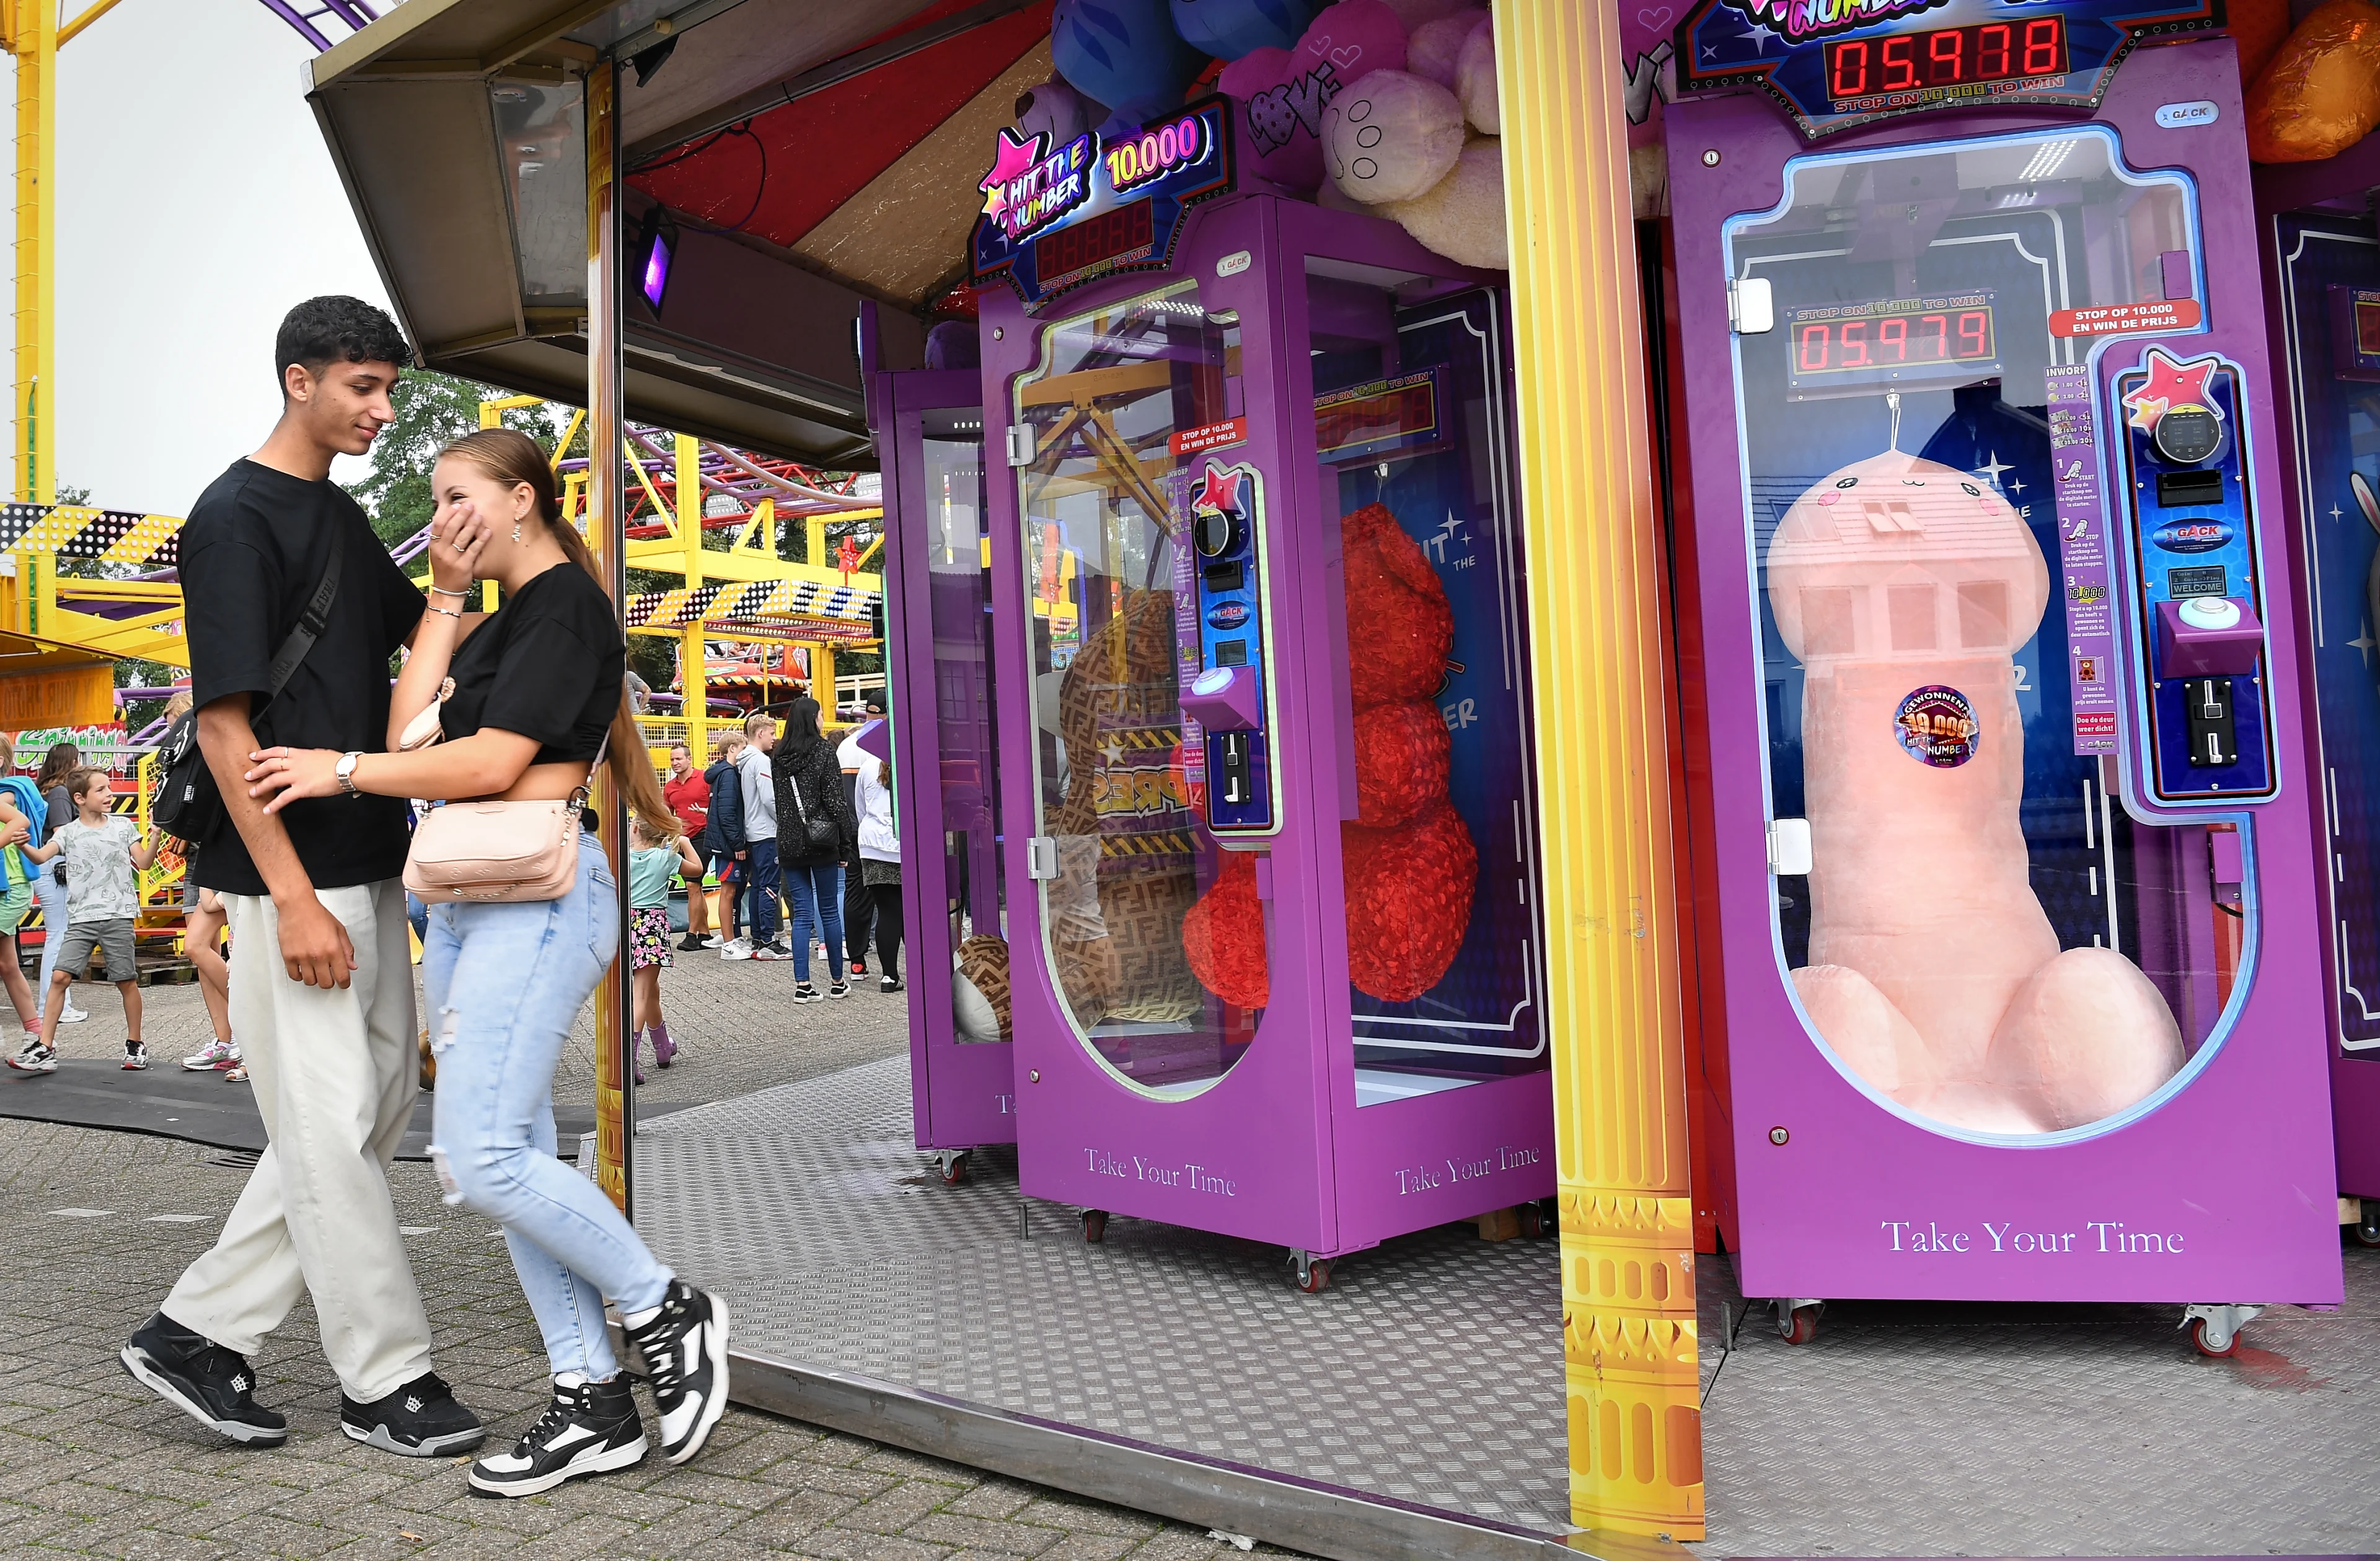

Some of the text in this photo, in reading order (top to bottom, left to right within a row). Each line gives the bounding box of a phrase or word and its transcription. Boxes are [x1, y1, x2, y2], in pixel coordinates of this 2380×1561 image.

[1834, 19, 2058, 95] 05.978
[1835, 76, 2064, 112] STOP ON 10.000 TO WIN
[1106, 115, 1198, 187] 10.000
[1009, 137, 1089, 208] HIT THE
[1008, 172, 1080, 234] NUMBER
[1039, 246, 1151, 294] STOP ON 10.000 TO WIN
[1797, 294, 1986, 321] STOP ON 10.000 TO WIN
[2075, 304, 2173, 321] STOP OP 10.000
[2073, 316, 2177, 332] EN WIN DE PRIJS
[1801, 312, 1986, 369] 05.979
[2046, 366, 2086, 377] INWORP
[1338, 390, 1353, 400] ON
[1388, 379, 1403, 389] TO
[1404, 371, 1429, 385] WIN
[1181, 422, 1234, 441] STOP OP 10.000
[1180, 431, 1236, 451] EN WIN DE PRIJS
[2056, 458, 2063, 469] 1
[1167, 467, 1189, 479] INWORP
[2061, 517, 2070, 528] 2
[2176, 524, 2219, 537] GACK
[1173, 544, 1177, 552] 1
[1453, 555, 1476, 572] THE
[2067, 575, 2076, 586] 3
[2174, 583, 2222, 593] WELCOME
[1175, 592, 1181, 600] 2
[2068, 586, 2105, 599] 10.000
[1220, 607, 1243, 617] GACK
[1178, 639, 1183, 647] 3
[2072, 645, 2081, 655] 4
[1905, 692, 1968, 714] GEWONNEN!
[1907, 737, 1919, 745] HIT
[1927, 745, 1968, 756] NUMBER
[1084, 1148, 1236, 1196] Take Your Time
[1395, 1146, 1540, 1195] Take Your Time
[1881, 1221, 2185, 1254] Take Your Time
